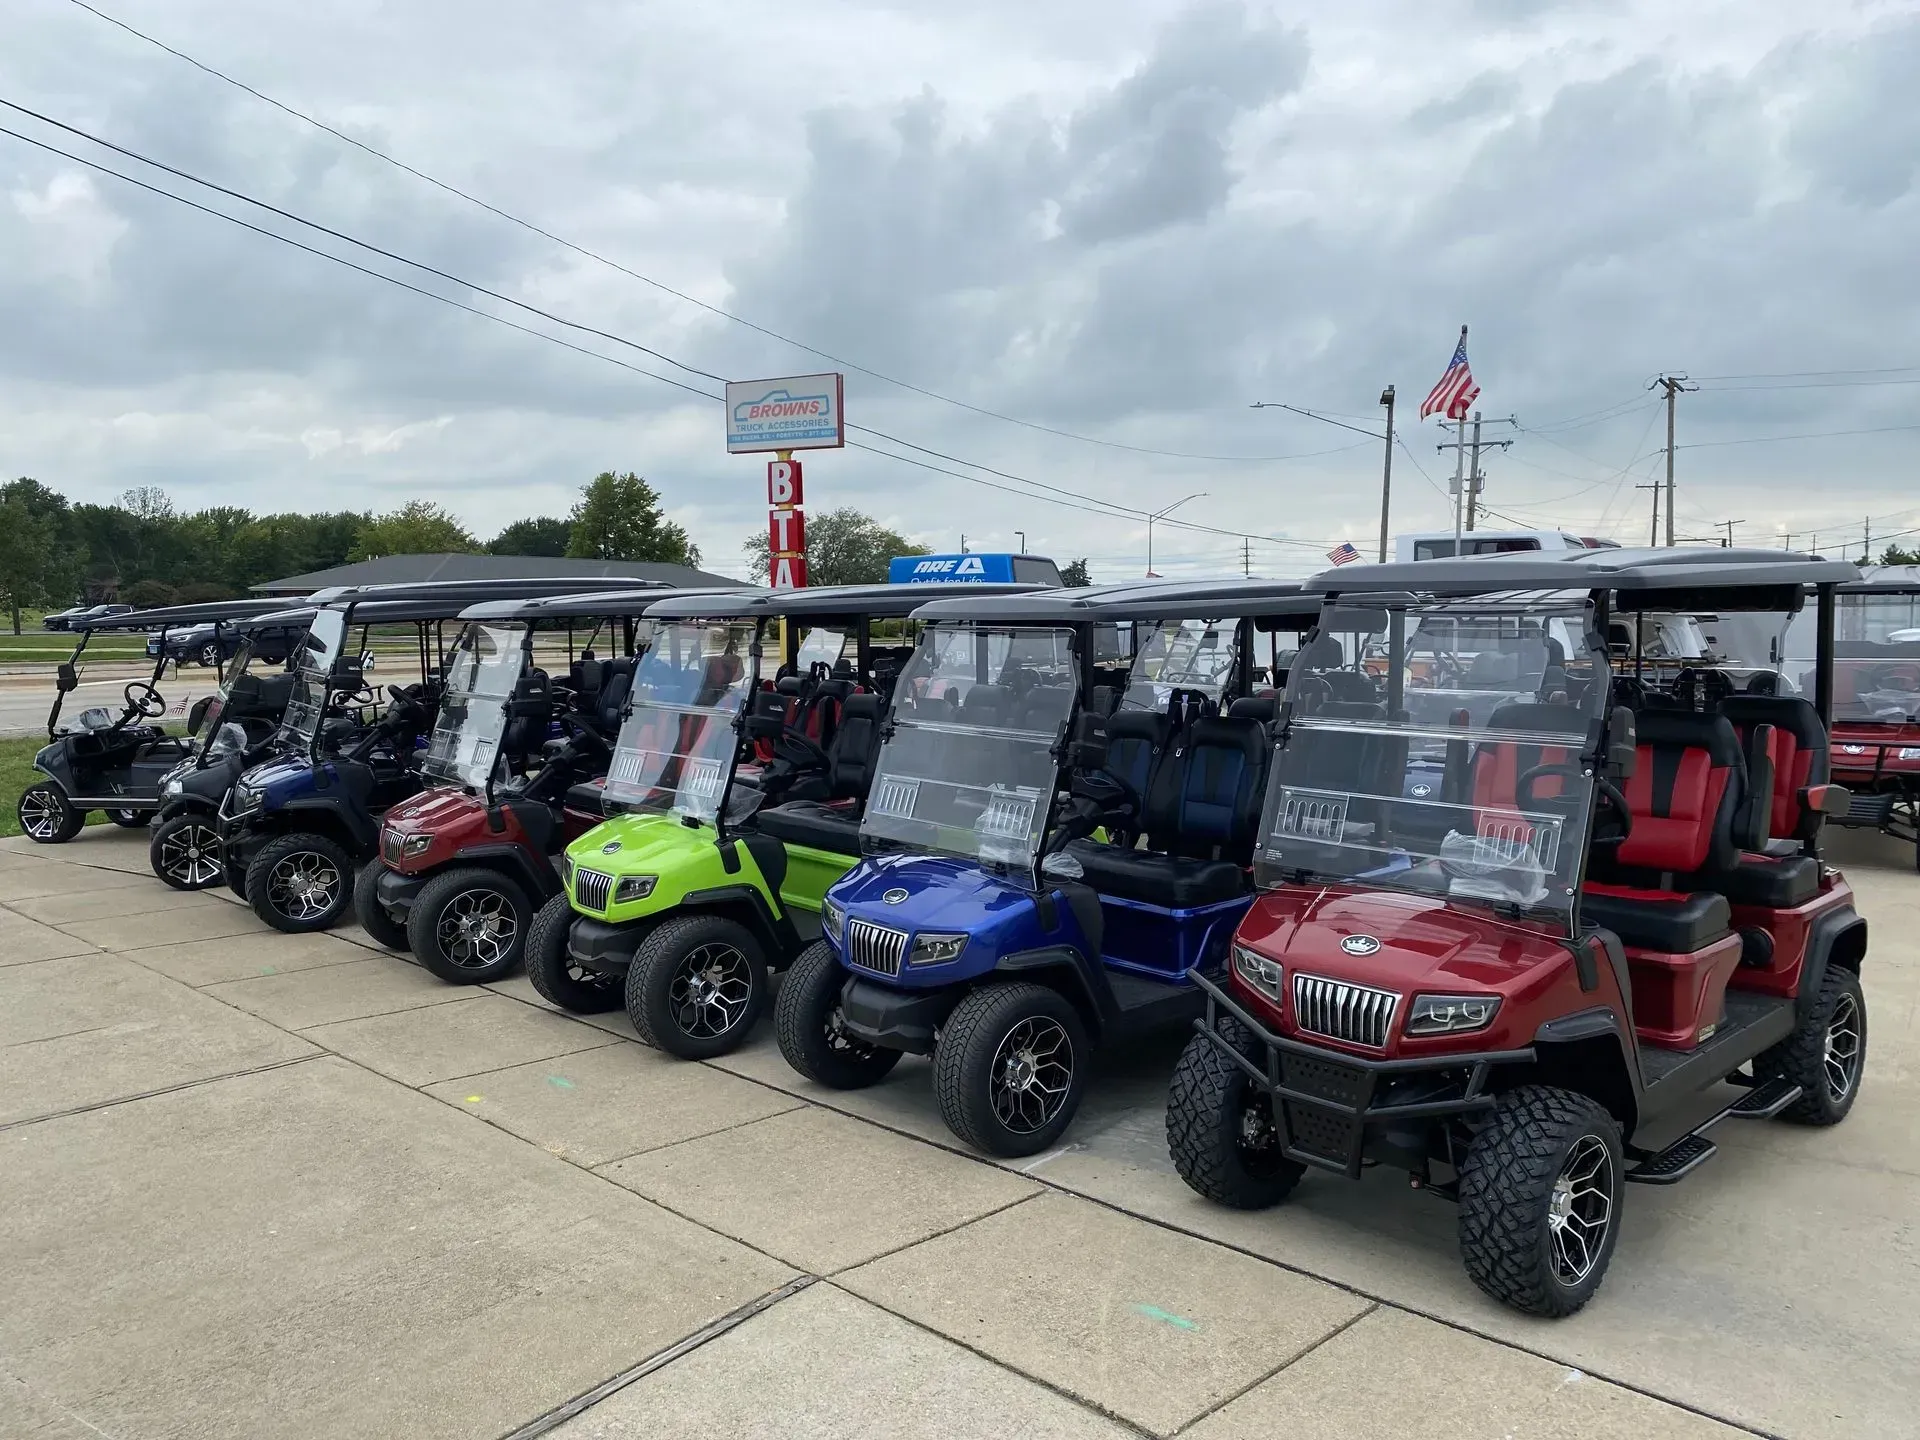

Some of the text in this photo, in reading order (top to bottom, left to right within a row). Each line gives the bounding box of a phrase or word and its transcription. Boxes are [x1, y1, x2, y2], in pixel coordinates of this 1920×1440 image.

[749, 401, 820, 418] BROWNS
[736, 419, 829, 433] TRUCK ACCESSORIES
[913, 560, 957, 573] ARE
